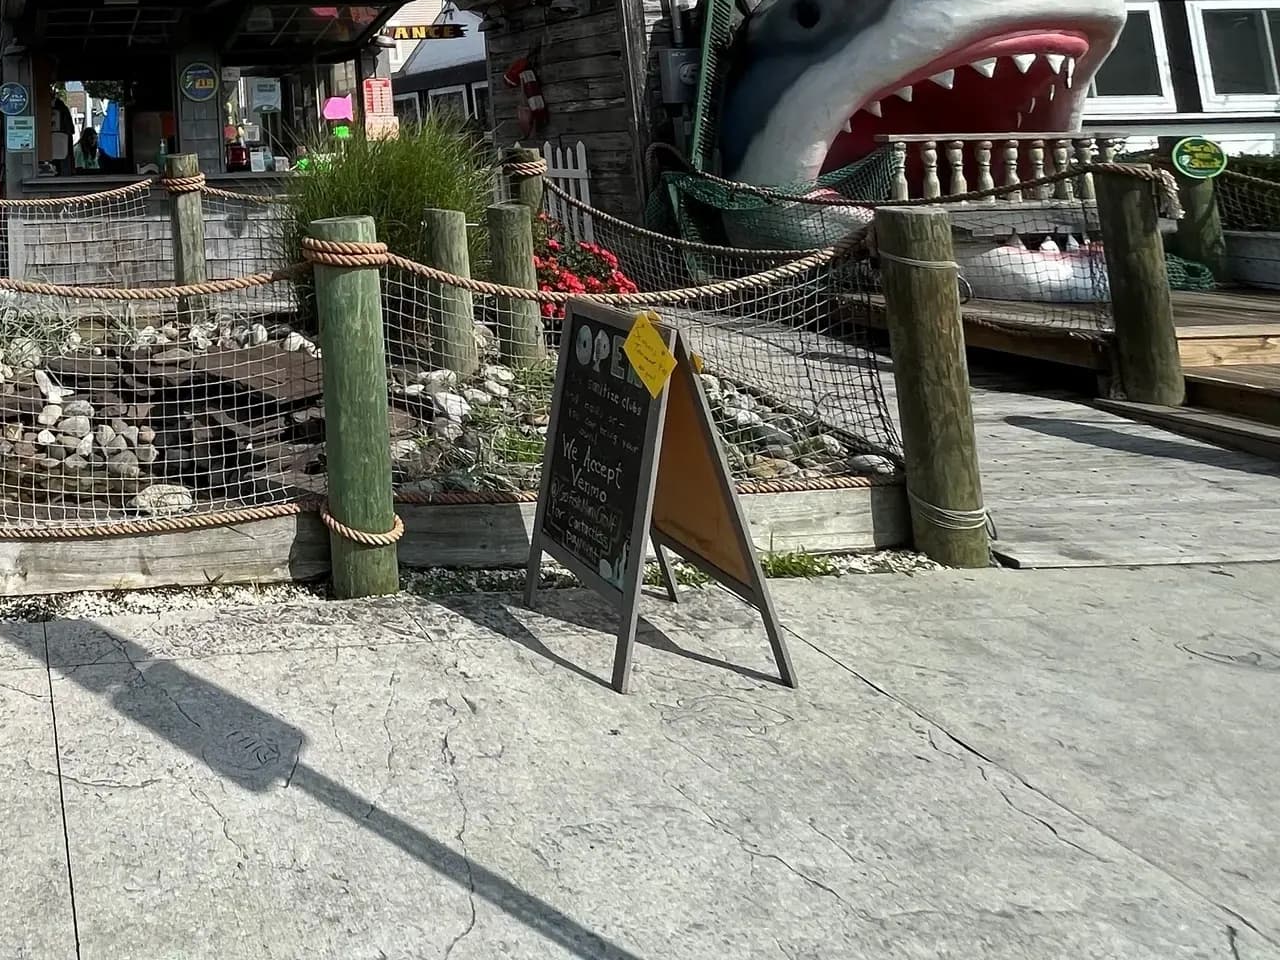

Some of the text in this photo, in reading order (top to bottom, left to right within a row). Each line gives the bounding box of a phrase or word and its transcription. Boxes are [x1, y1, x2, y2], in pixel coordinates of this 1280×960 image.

[394, 25, 455, 39] ANCE
[562, 433, 624, 489] We Accept
[571, 463, 608, 503] Venmo
